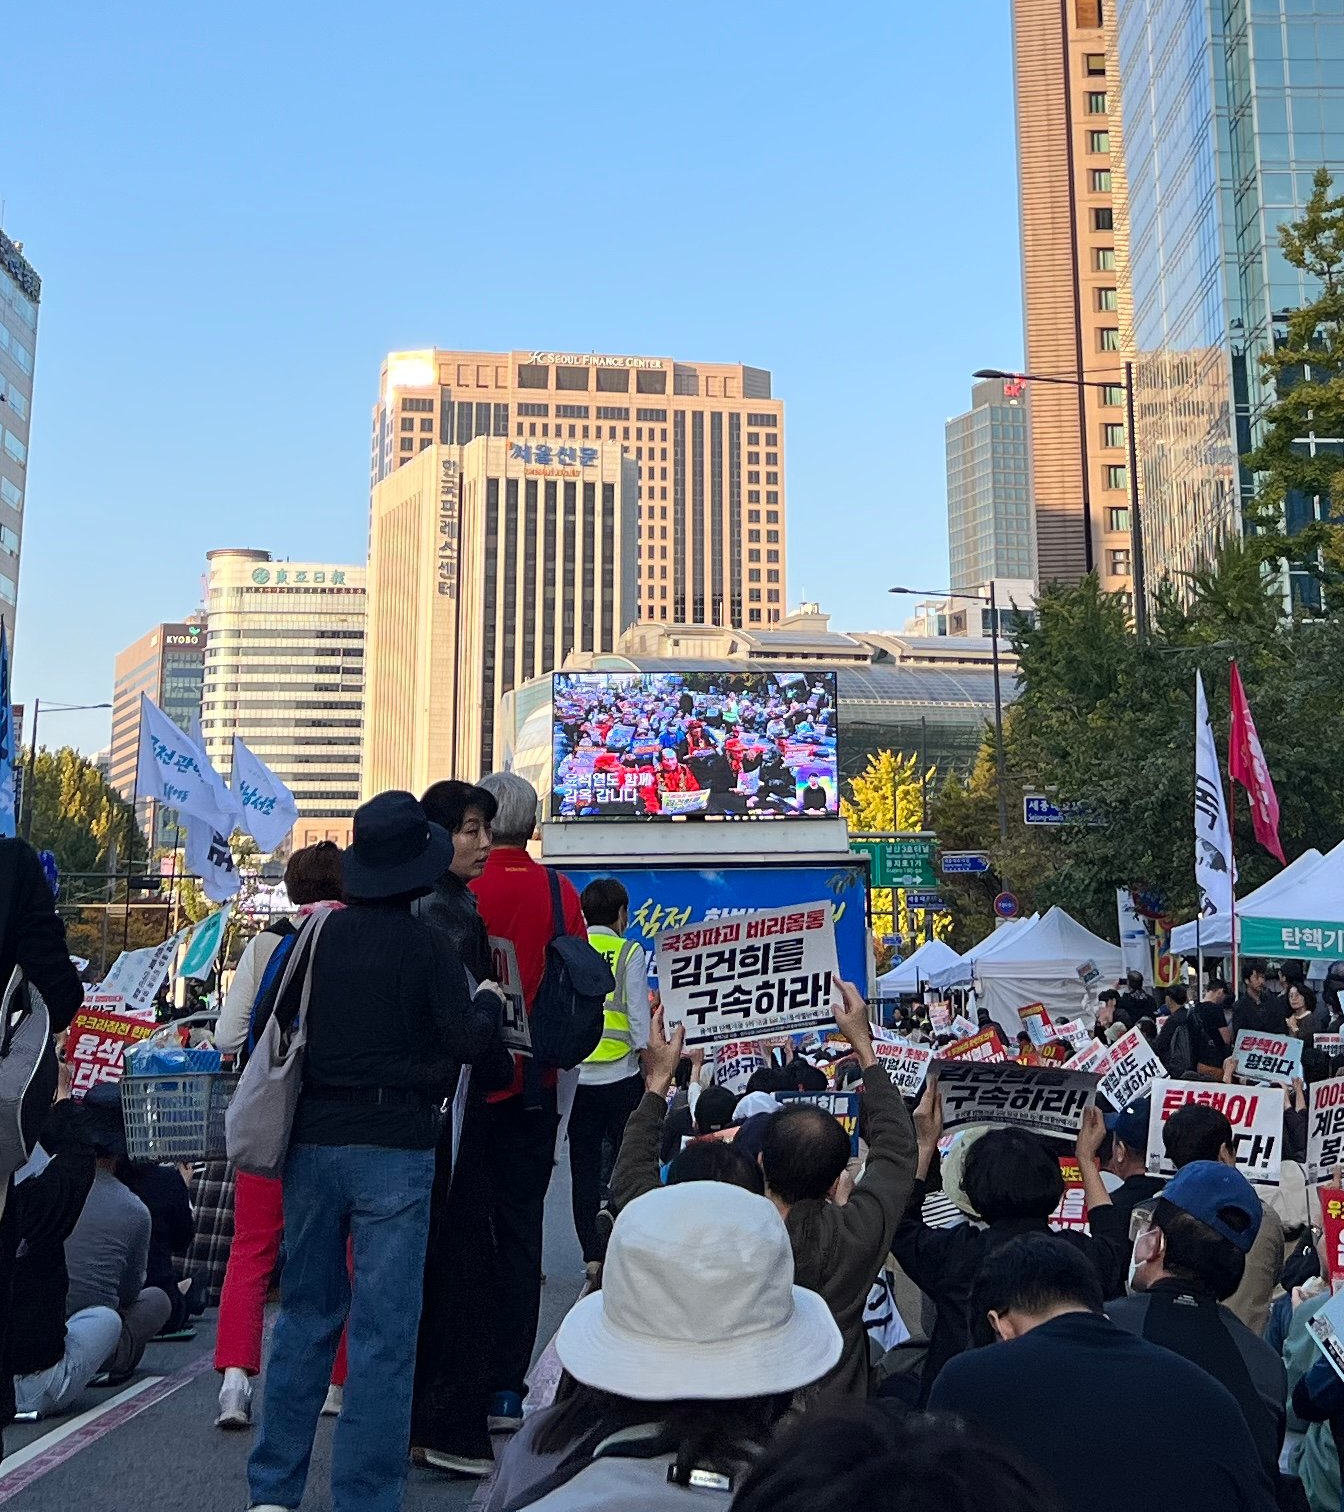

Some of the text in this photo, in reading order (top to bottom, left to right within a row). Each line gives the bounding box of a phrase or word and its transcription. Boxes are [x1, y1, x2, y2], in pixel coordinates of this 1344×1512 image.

[548, 352, 582, 365] SEOUL
[582, 354, 624, 367] FINANCE
[625, 357, 663, 369] CENTER
[510, 442, 599, 468] 서울신문
[438, 458, 457, 600] 한국프레스센터
[166, 635, 199, 645] KYOBO
[661, 923, 740, 953] 국정파괴
[746, 908, 825, 938] 비리몸통
[670, 937, 805, 990] 김건희를
[686, 970, 832, 1026] 구속하라!
[1239, 1035, 1289, 1058] 탄핵이
[1244, 1052, 1295, 1077] 평화다
[945, 1084, 1090, 1119] 구속하라!
